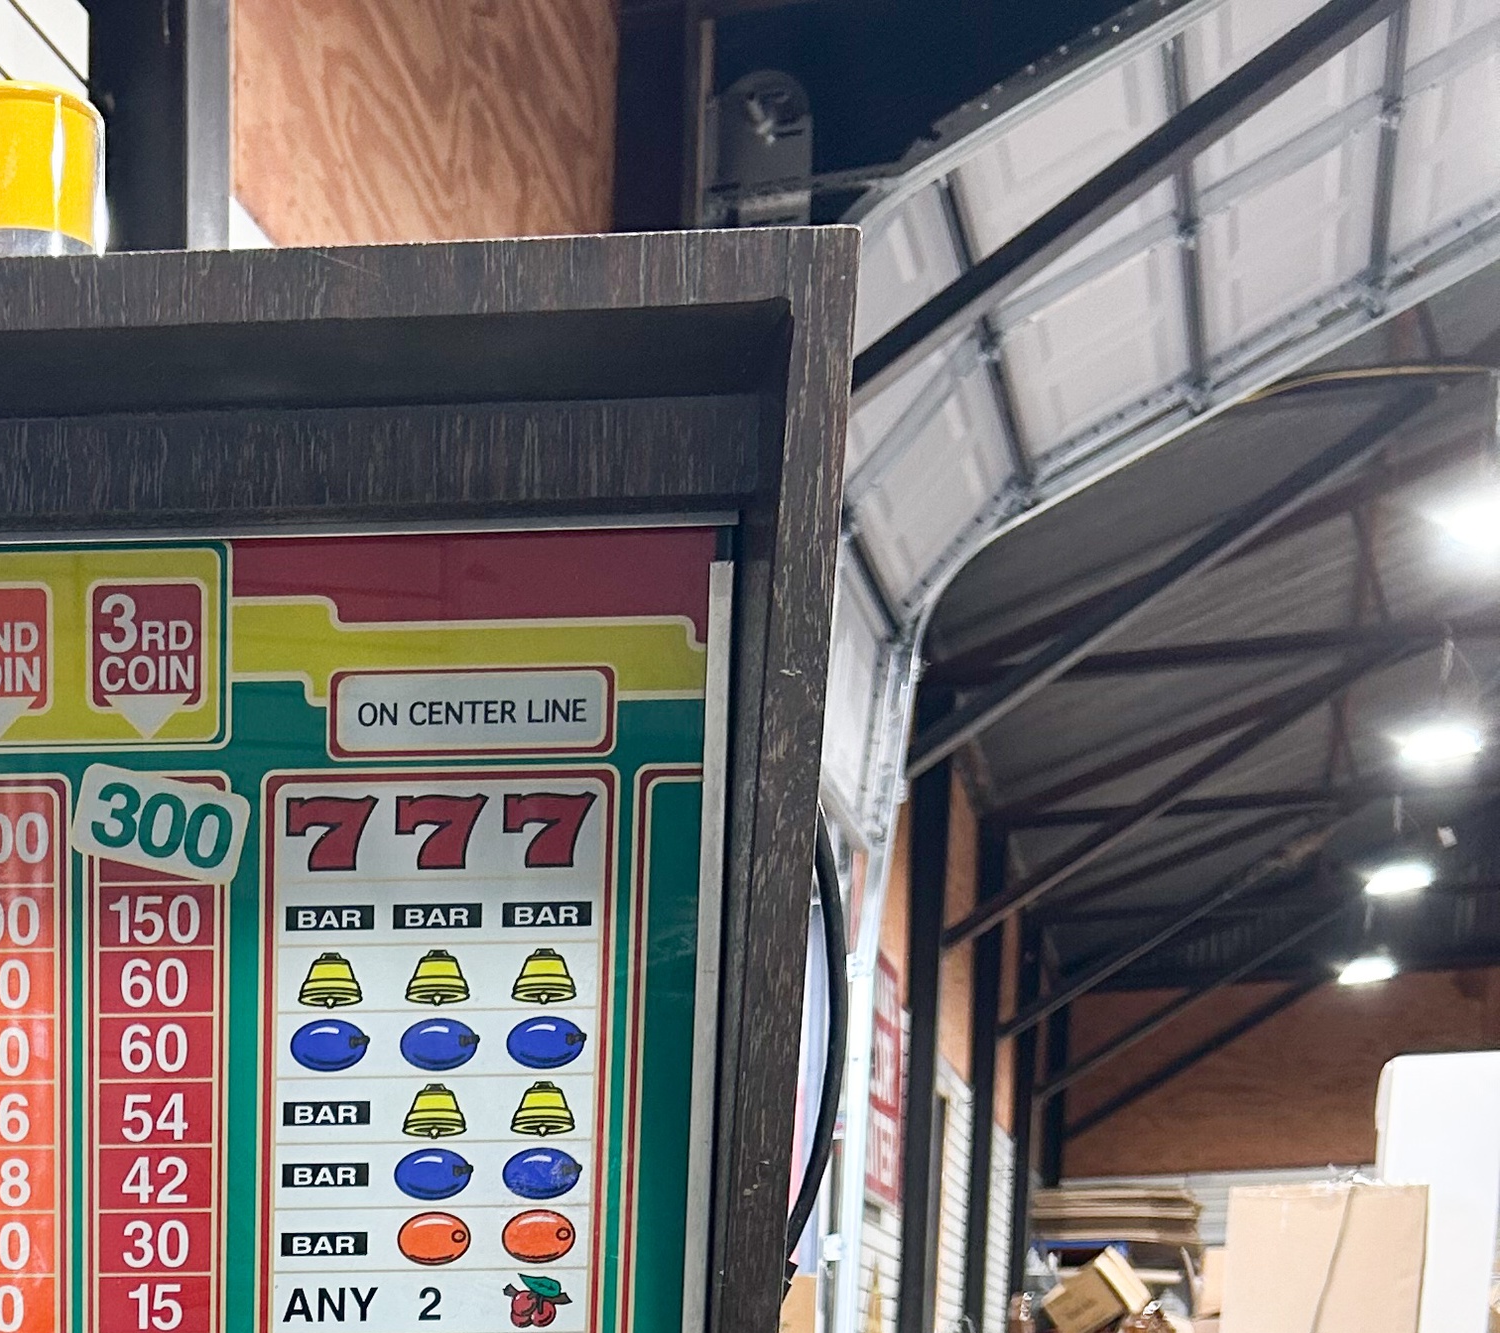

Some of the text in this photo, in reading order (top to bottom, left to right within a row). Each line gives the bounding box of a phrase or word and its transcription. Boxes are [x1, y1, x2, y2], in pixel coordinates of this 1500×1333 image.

[100, 594, 193, 652] 3RD
[100, 655, 194, 692] COIN
[357, 698, 588, 727] ON CENTER LINE
[90, 781, 233, 869] 300
[286, 791, 598, 872] 7 7 7
[108, 894, 200, 944] 150
[297, 904, 579, 929] BAR BAR BAR
[121, 958, 188, 1008] 60
[121, 1024, 188, 1073] 60
[122, 1092, 188, 1142] 54
[294, 1103, 358, 1125] BAR
[121, 1156, 188, 1203] 42
[292, 1164, 357, 1186] BAR
[122, 1220, 189, 1269] 30
[291, 1233, 355, 1255] BAR
[128, 1284, 182, 1331] 15
[283, 1287, 442, 1323] ANY 2
